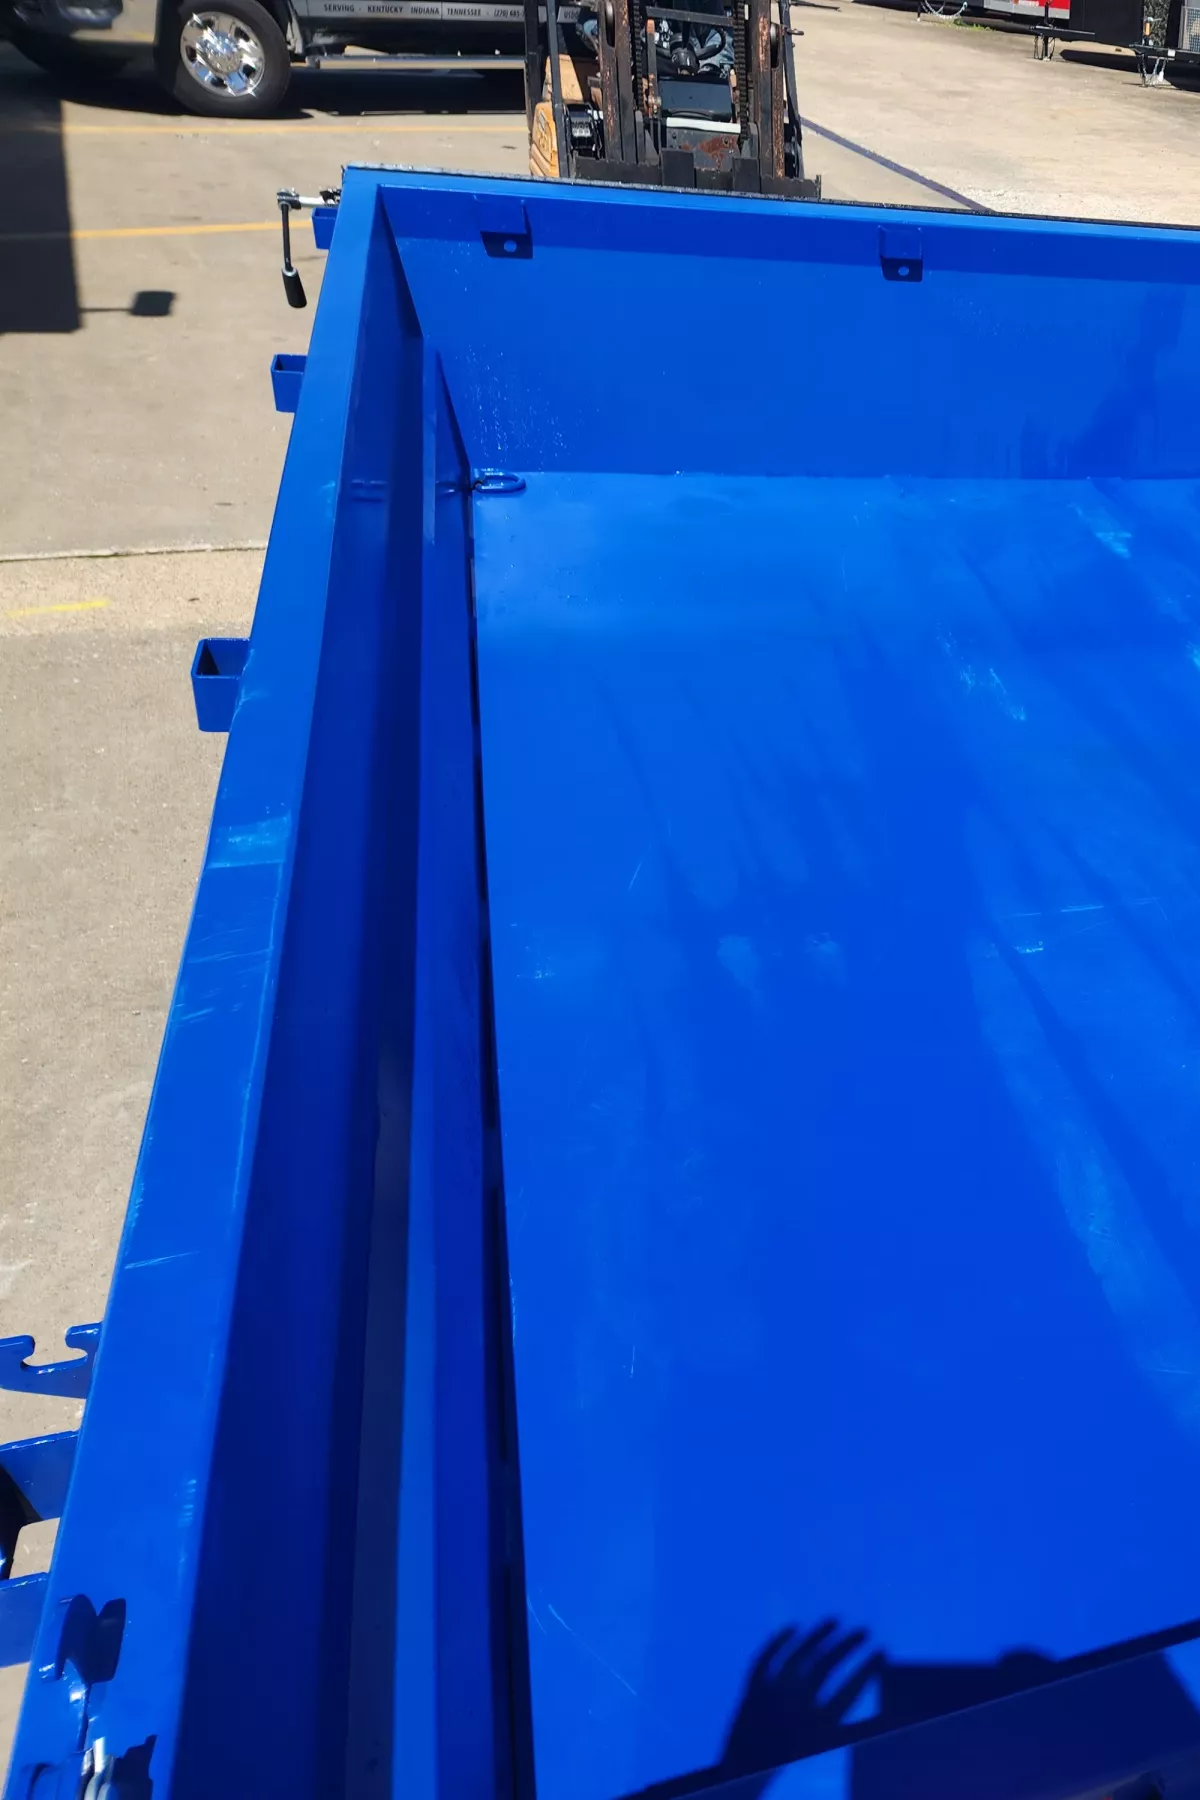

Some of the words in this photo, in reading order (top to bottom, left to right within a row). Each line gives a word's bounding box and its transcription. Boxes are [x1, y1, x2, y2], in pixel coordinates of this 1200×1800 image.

[324, 3, 355, 12] SERVING
[366, 4, 404, 14] KENTUCKY
[410, 5, 441, 15] INDIANA
[447, 8, 481, 17] TENNESSEE
